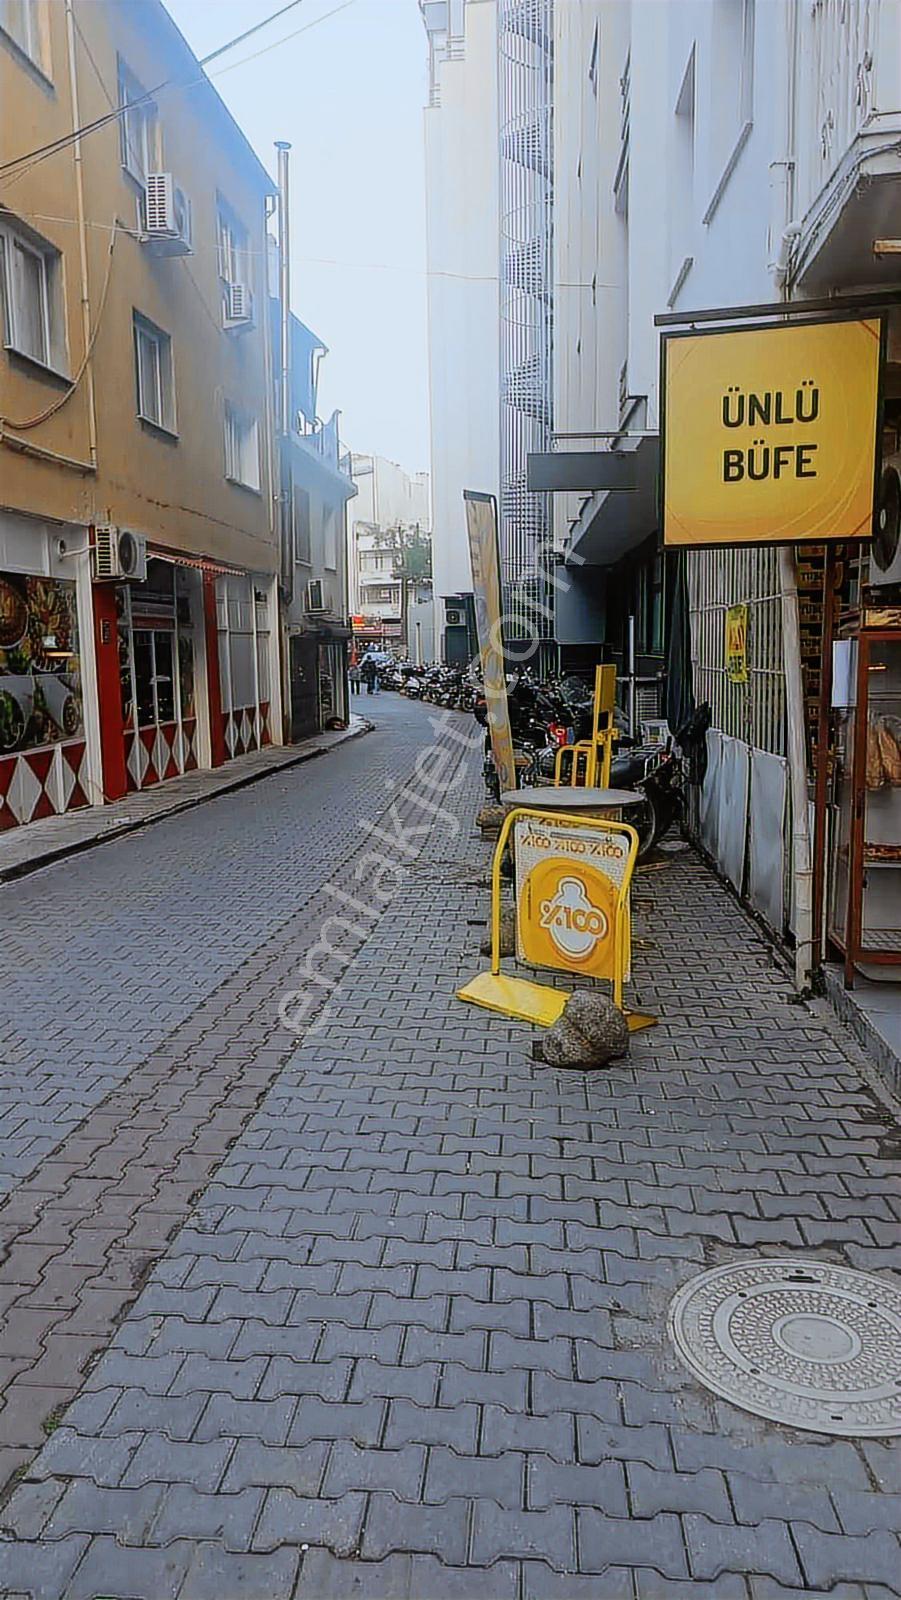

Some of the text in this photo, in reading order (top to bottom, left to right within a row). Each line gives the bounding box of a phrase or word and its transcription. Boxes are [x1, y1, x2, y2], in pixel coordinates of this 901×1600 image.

[722, 380, 820, 428] ÜNLÜ
[723, 439, 818, 482] BÜFE
[542, 903, 605, 936] %100
